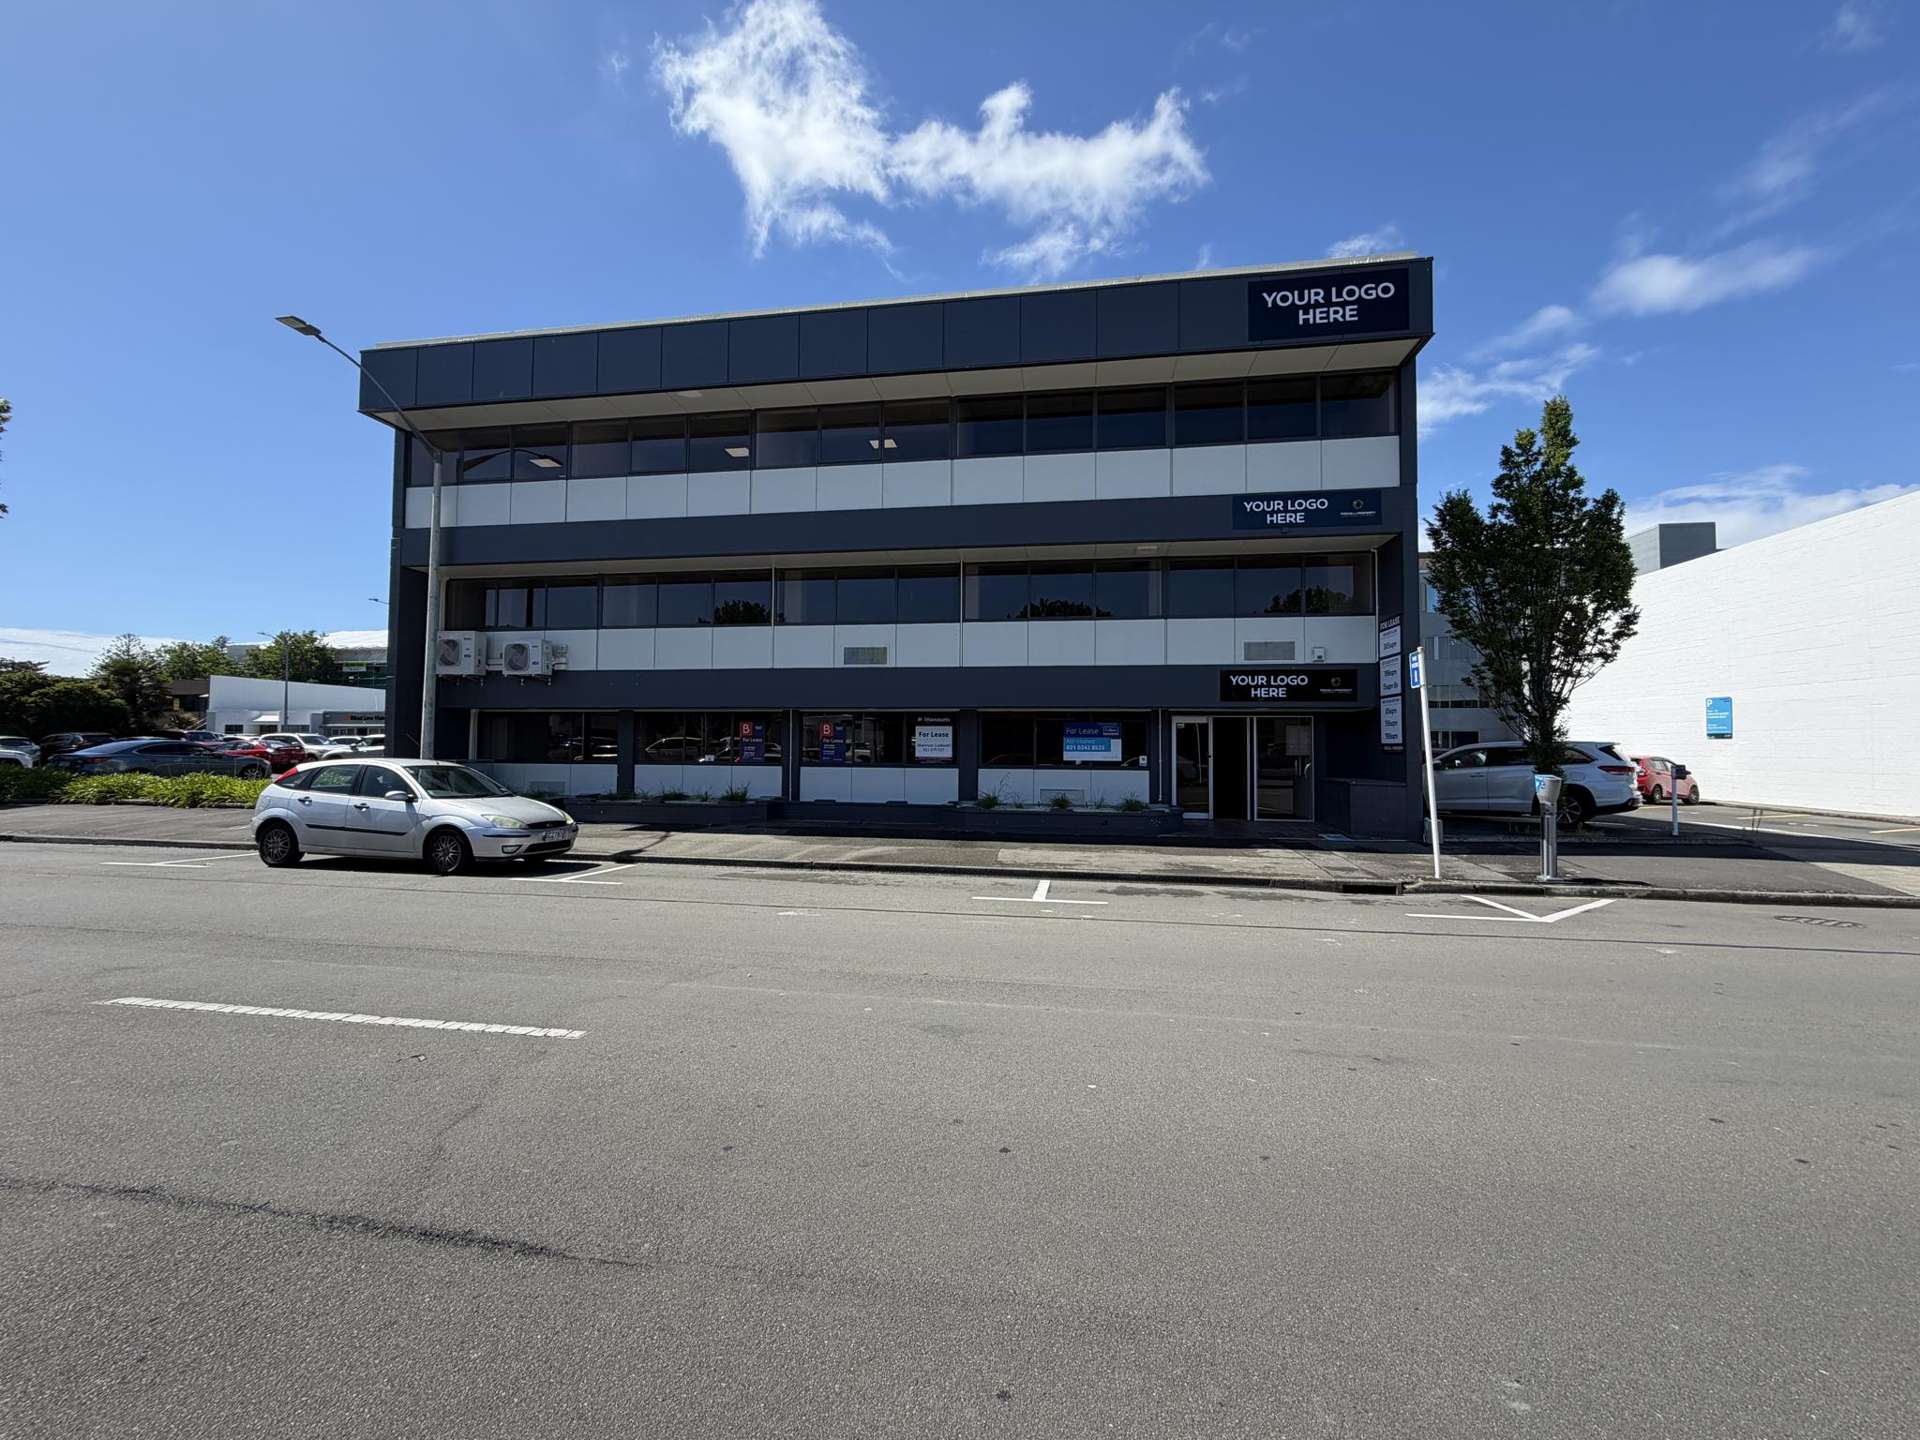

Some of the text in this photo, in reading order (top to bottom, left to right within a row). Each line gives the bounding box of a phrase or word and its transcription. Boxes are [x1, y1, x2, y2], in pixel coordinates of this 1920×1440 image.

[1262, 282, 1396, 308] YOUR LOGO
[1298, 305, 1359, 325] HERE
[1243, 498, 1329, 512] YOUR LOGO
[1266, 512, 1305, 524] HERE
[1229, 675, 1309, 686] YOUR LOGO
[1250, 687, 1287, 698] HERE
[1078, 727, 1099, 735] Lease
